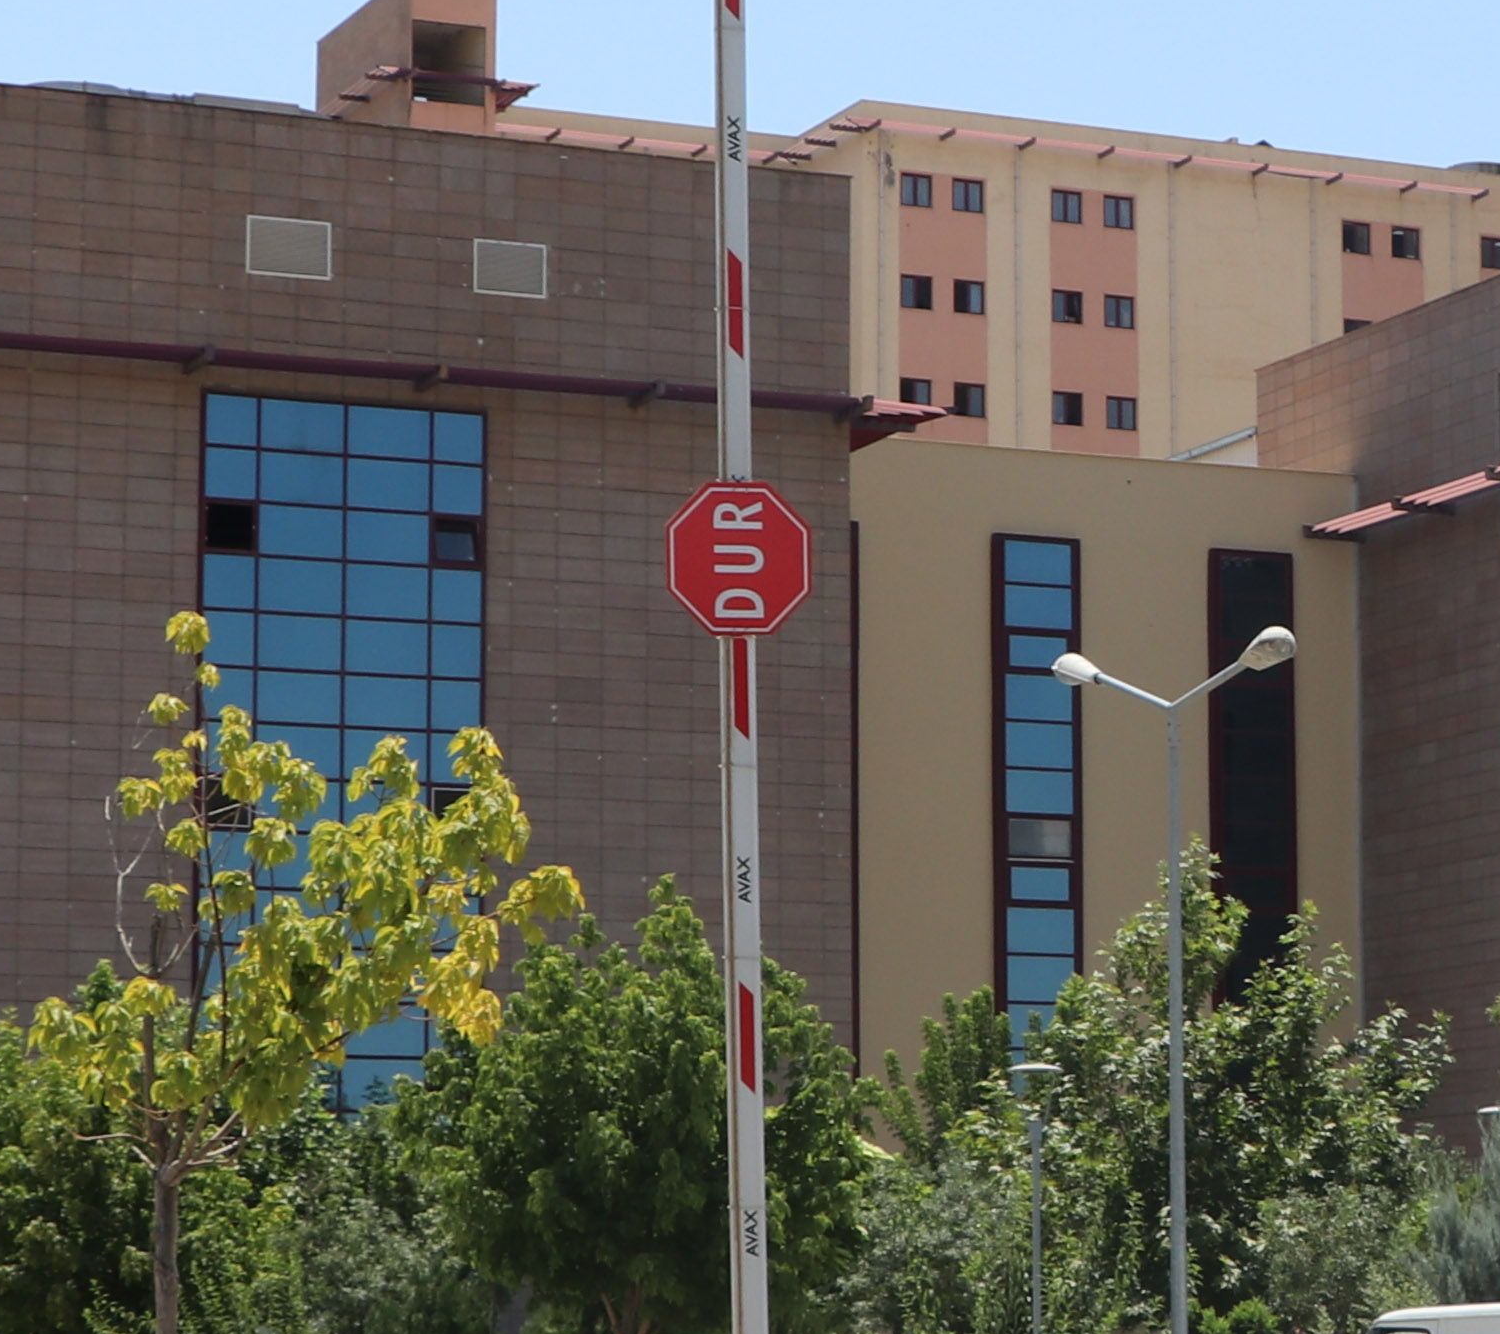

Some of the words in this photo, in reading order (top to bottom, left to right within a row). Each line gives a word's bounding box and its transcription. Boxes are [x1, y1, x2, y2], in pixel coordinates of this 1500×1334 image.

[727, 115, 741, 163] AVAX
[713, 501, 765, 619] DUR
[736, 856, 752, 903] AVAX
[744, 1210, 759, 1257] AVAX
